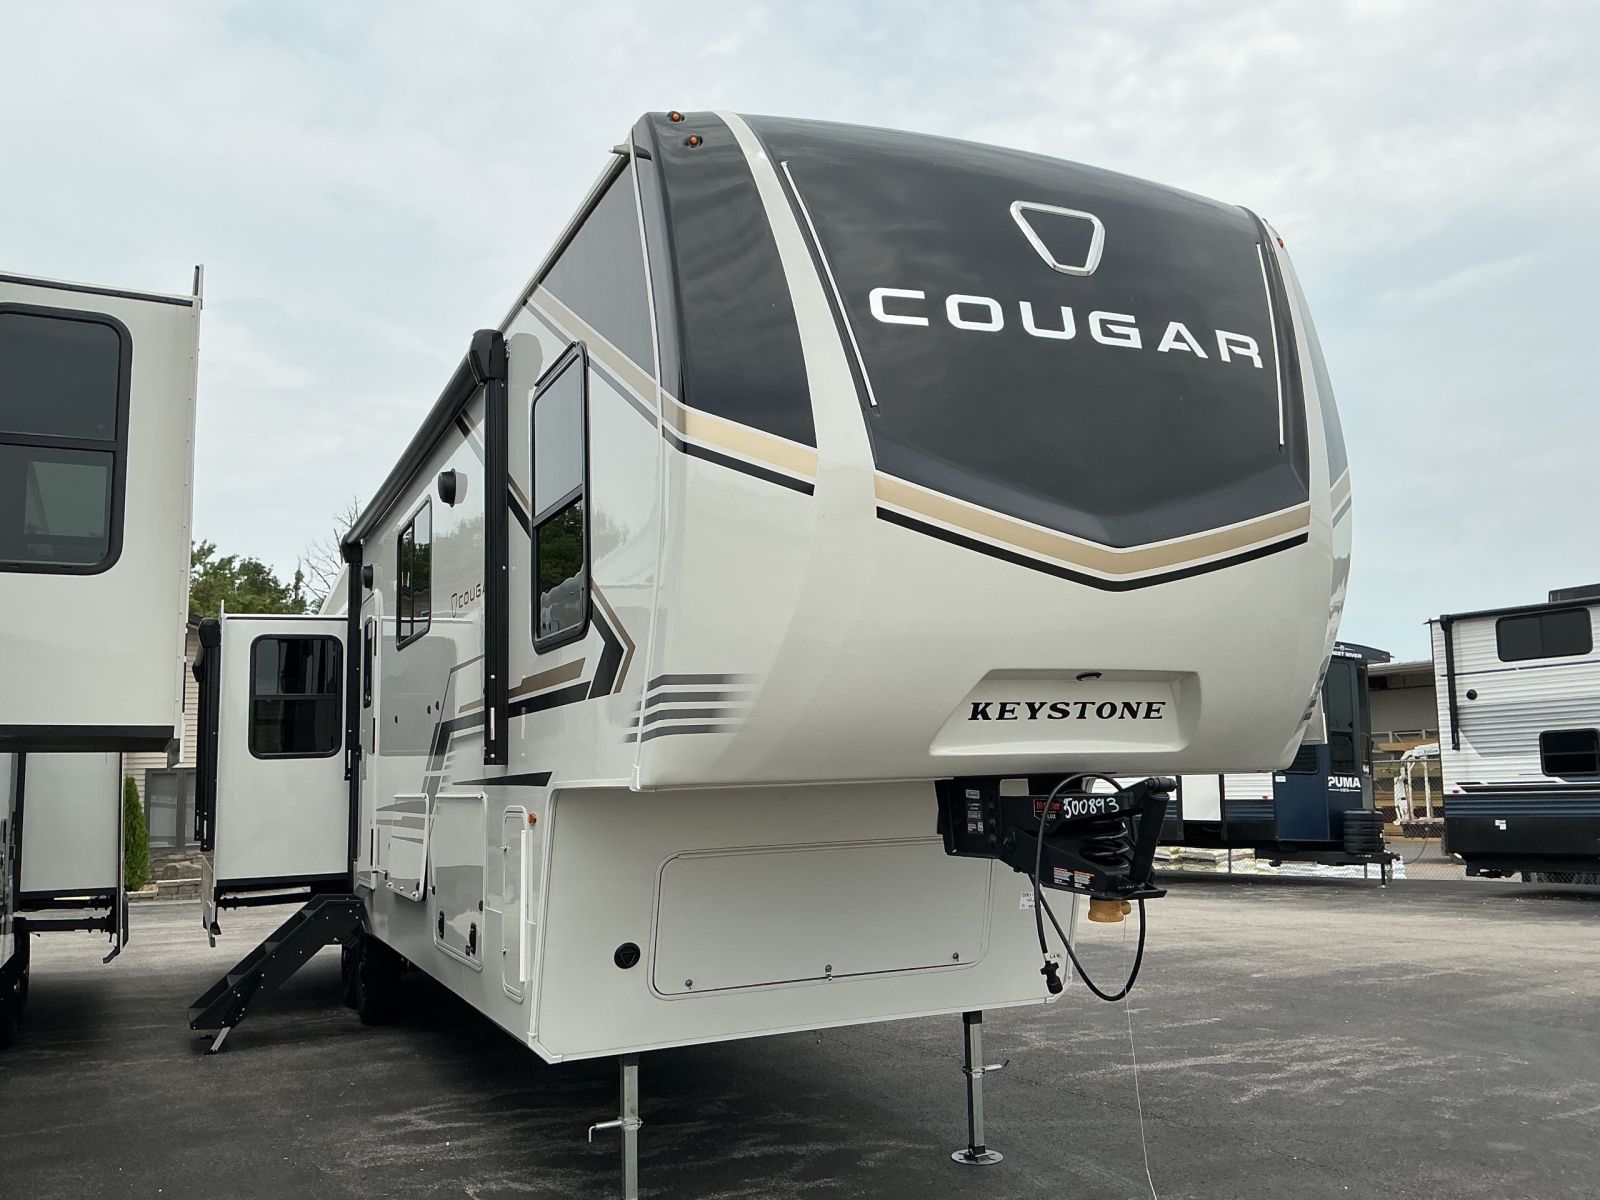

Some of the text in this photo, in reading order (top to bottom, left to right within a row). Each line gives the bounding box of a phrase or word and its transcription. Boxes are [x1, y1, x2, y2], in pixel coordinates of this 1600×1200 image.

[868, 287, 1263, 369] COUGAR
[458, 583, 485, 608] COUG
[1345, 651, 1362, 659] RIVER
[968, 701, 1166, 721] KEYSTONE
[1327, 776, 1361, 788] PUMA
